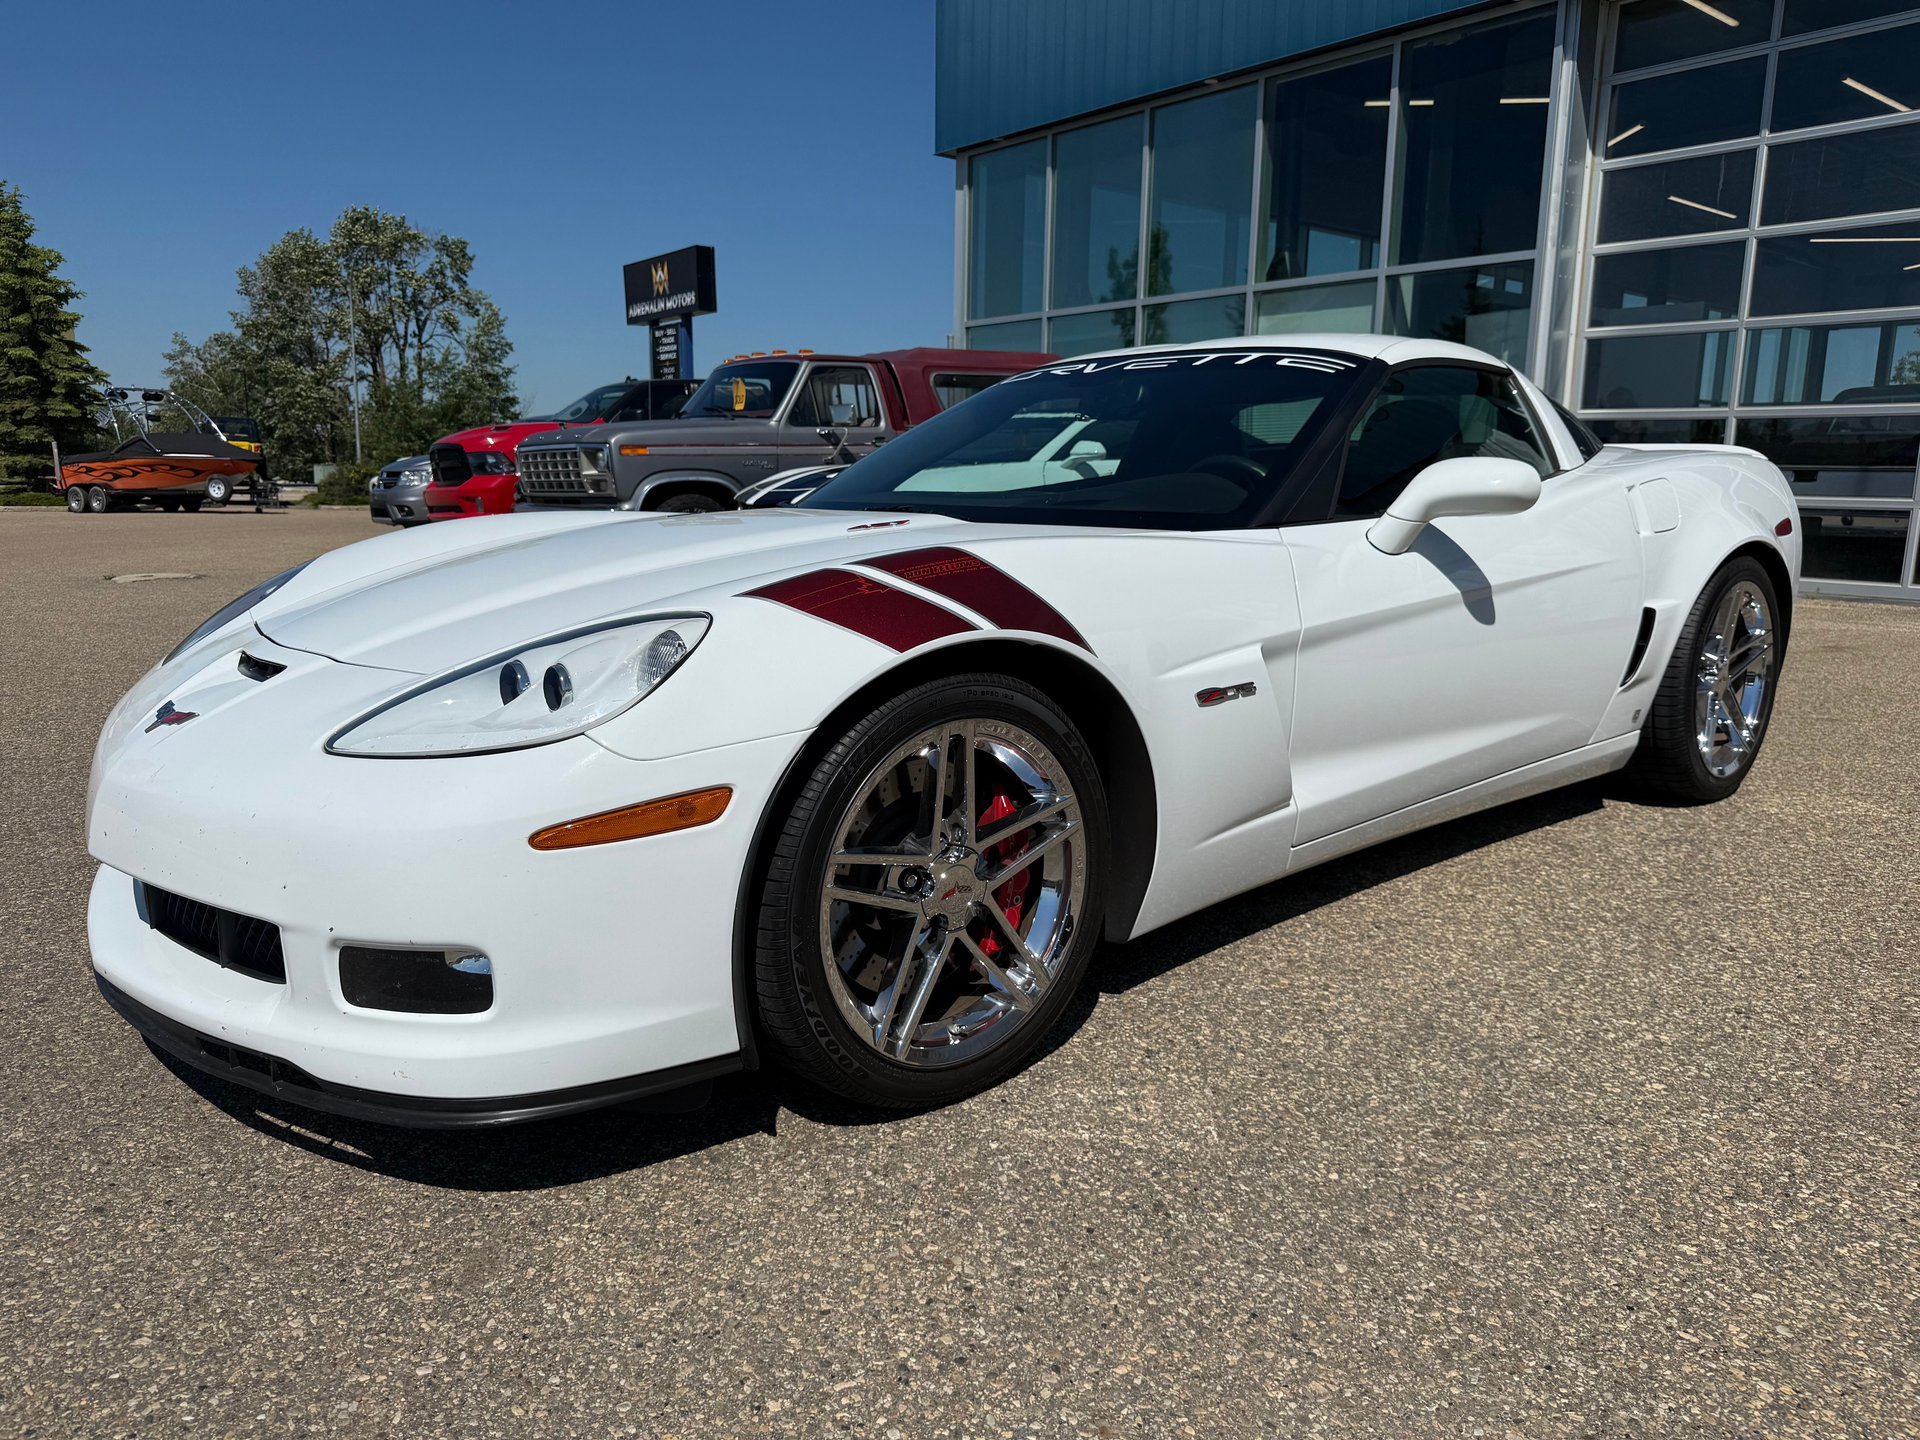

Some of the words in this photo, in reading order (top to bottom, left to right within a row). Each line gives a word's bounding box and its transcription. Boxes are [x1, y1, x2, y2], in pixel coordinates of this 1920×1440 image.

[628, 297, 665, 318] ADRENALIN
[666, 291, 695, 310] MOTORS
[1000, 352, 1357, 384] ORVETTE
